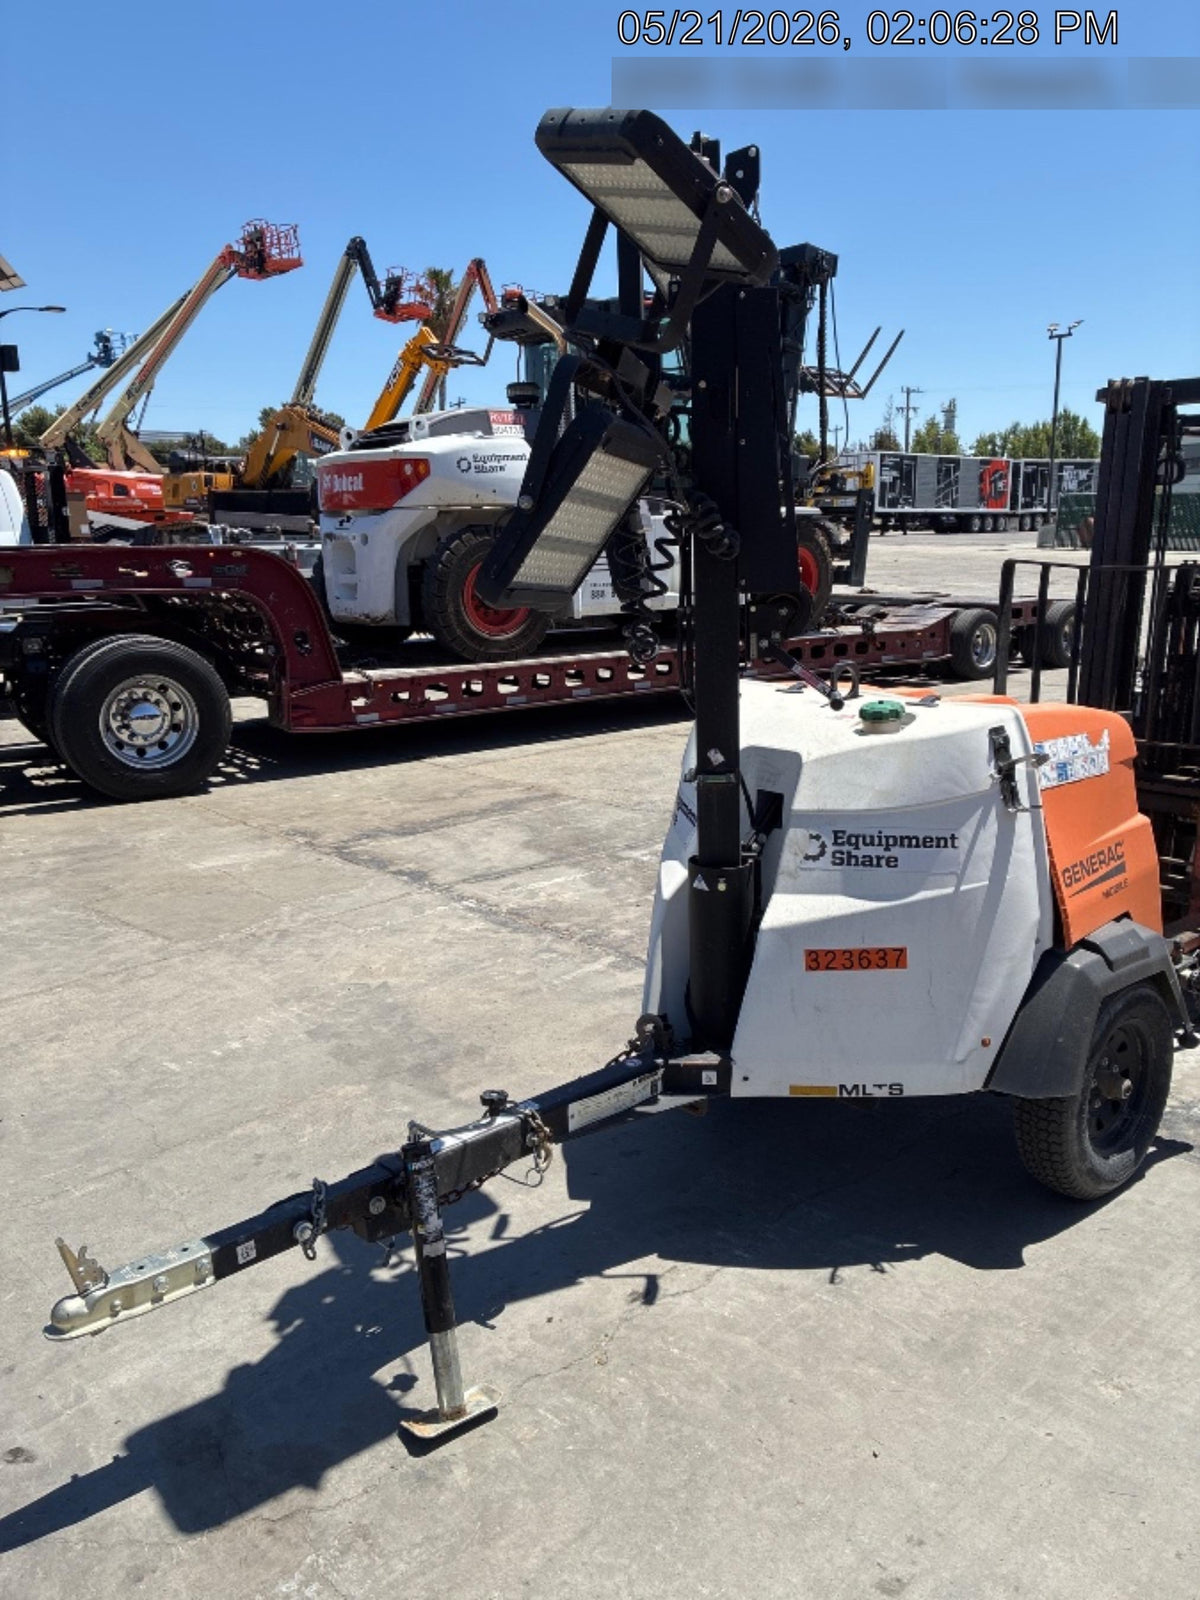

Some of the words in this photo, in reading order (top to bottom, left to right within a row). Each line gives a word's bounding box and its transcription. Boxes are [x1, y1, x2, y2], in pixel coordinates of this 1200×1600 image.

[831, 829, 959, 851] Equipment
[830, 849, 899, 868] Share
[1061, 840, 1125, 888] GENERAC
[808, 948, 905, 971] 323637
